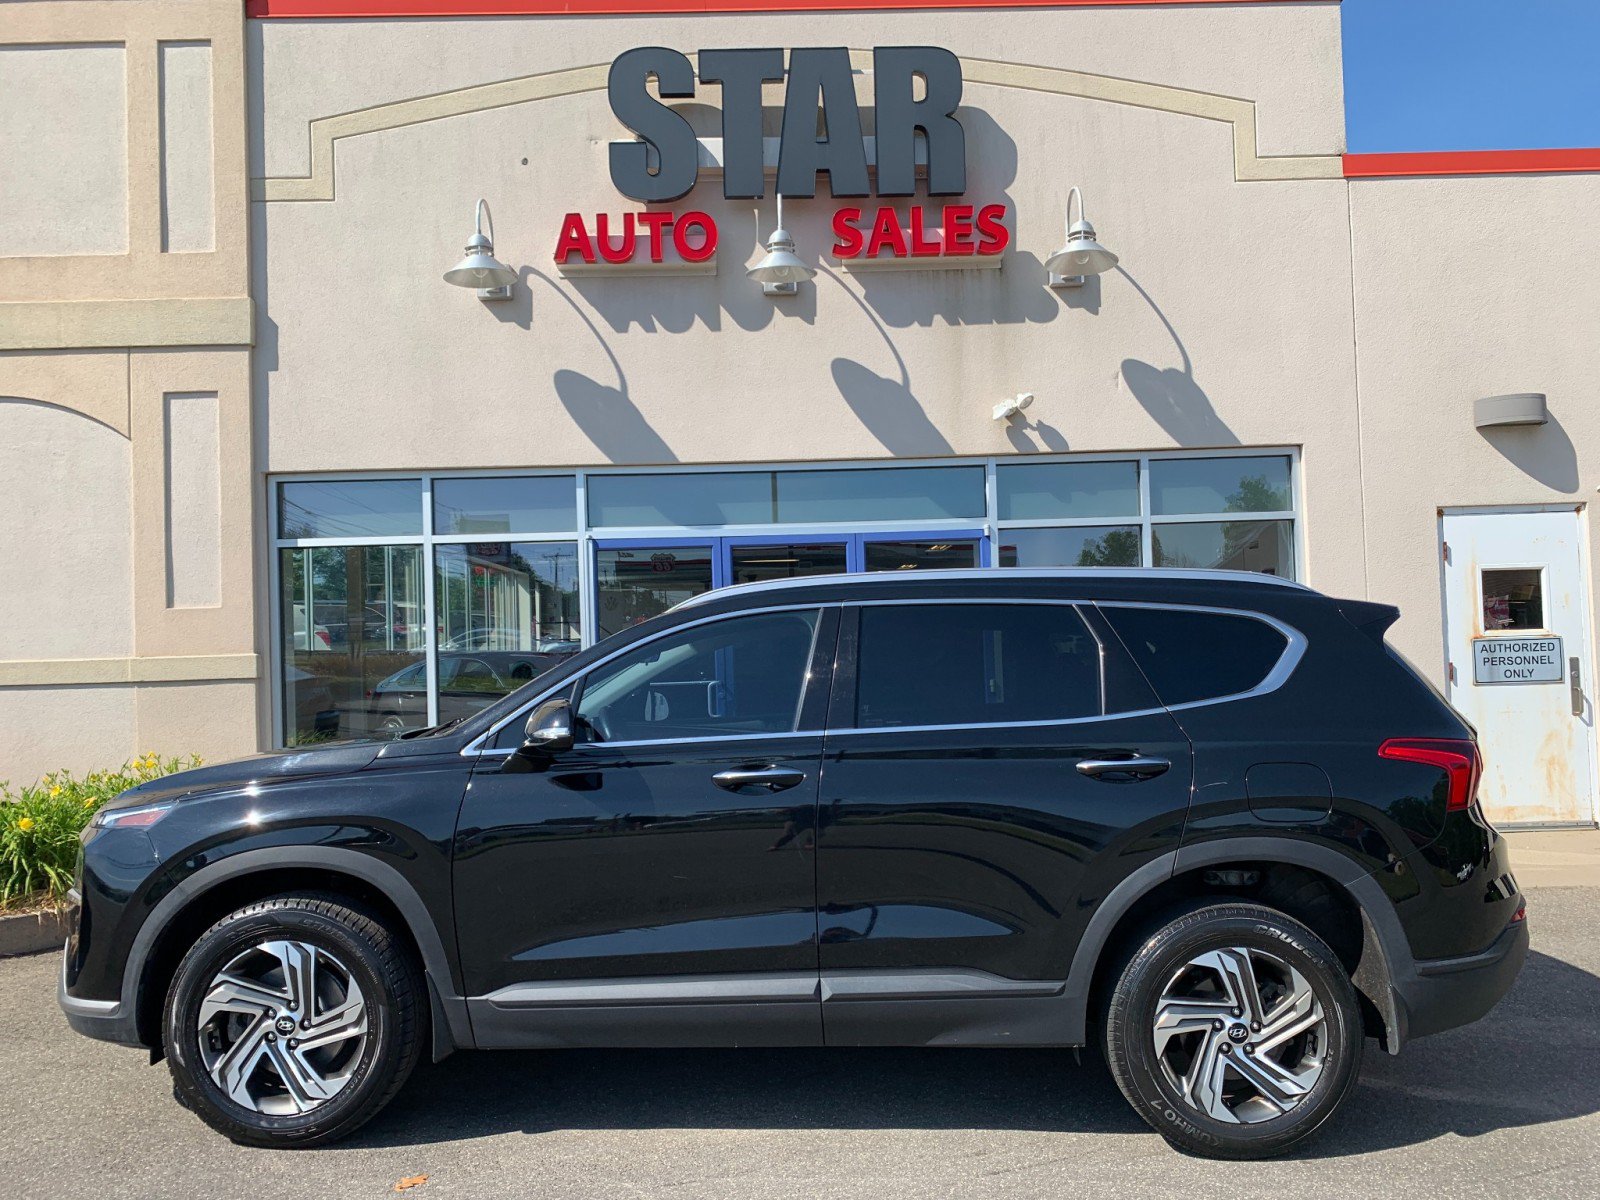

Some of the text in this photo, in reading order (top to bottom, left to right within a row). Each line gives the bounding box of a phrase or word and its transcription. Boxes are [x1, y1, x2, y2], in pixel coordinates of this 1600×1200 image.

[608, 46, 966, 203] STAR
[553, 203, 1010, 265] AUTO SALES
[1480, 642, 1555, 653] AUTHORIZED
[1483, 655, 1554, 666] PERSONNEL
[1504, 669, 1534, 678] ONLY
